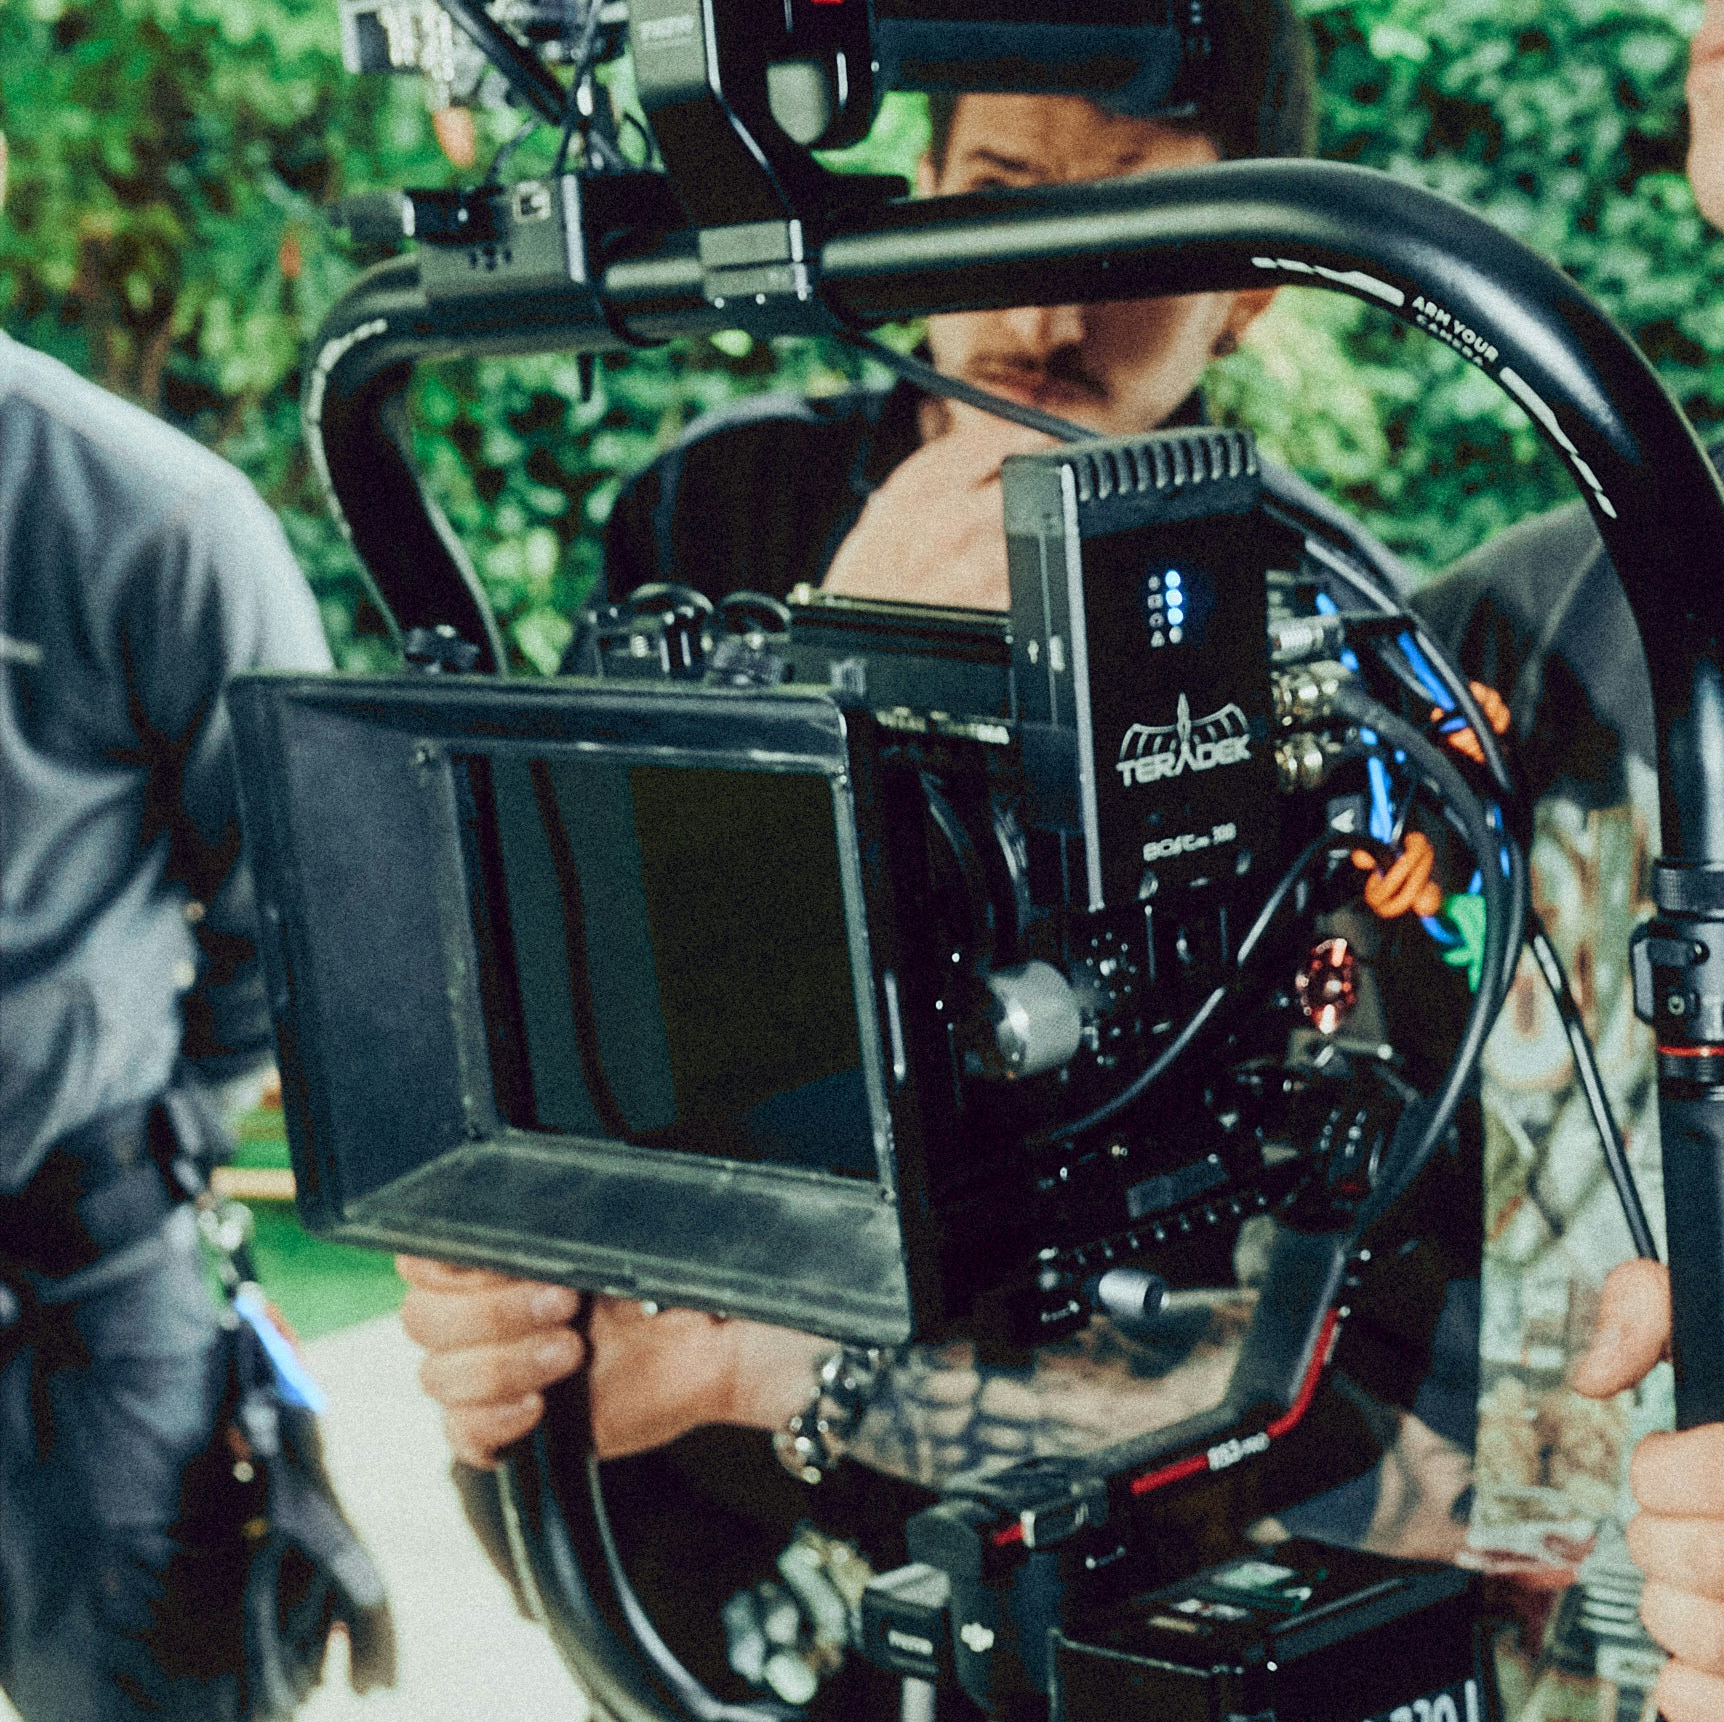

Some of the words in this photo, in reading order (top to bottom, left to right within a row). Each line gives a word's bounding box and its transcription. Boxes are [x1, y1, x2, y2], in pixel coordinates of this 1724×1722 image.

[1412, 296, 1451, 327] ARM
[1453, 319, 1499, 363] YOUR
[1115, 733, 1252, 787] TERADEK
